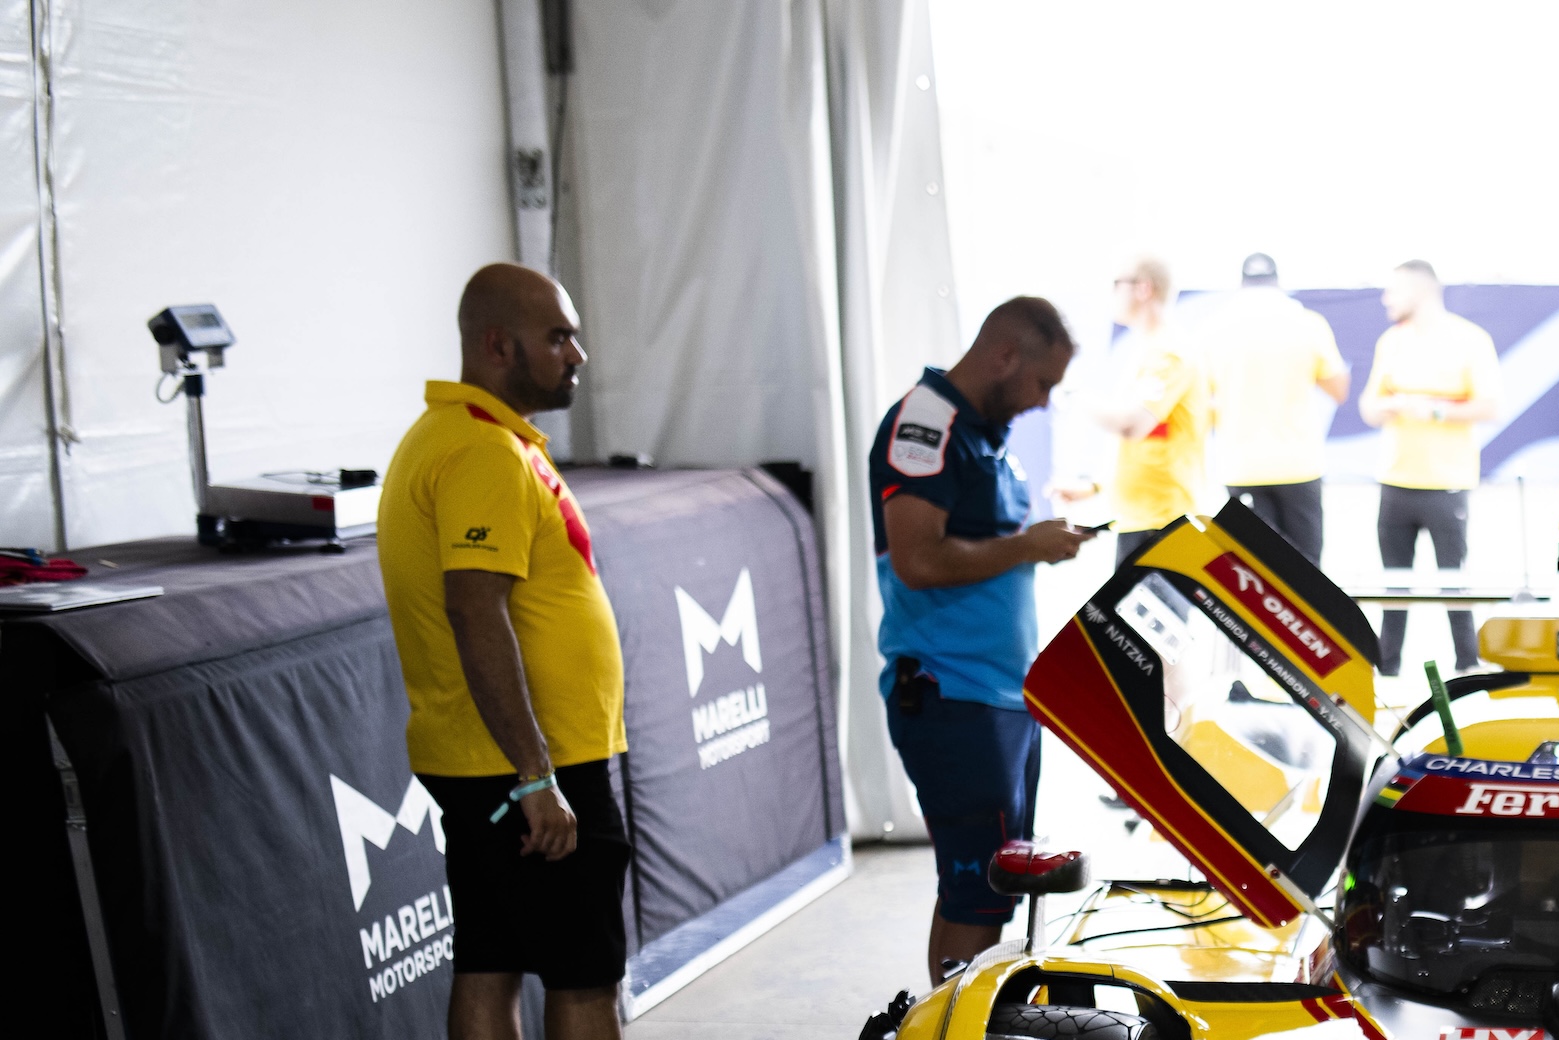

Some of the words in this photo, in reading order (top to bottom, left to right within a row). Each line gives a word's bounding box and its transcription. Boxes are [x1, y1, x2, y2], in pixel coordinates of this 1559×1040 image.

[1105, 624, 1154, 676] NATZKA
[1262, 596, 1331, 659] ORLEN
[369, 933, 455, 1003] MOTORSPO
